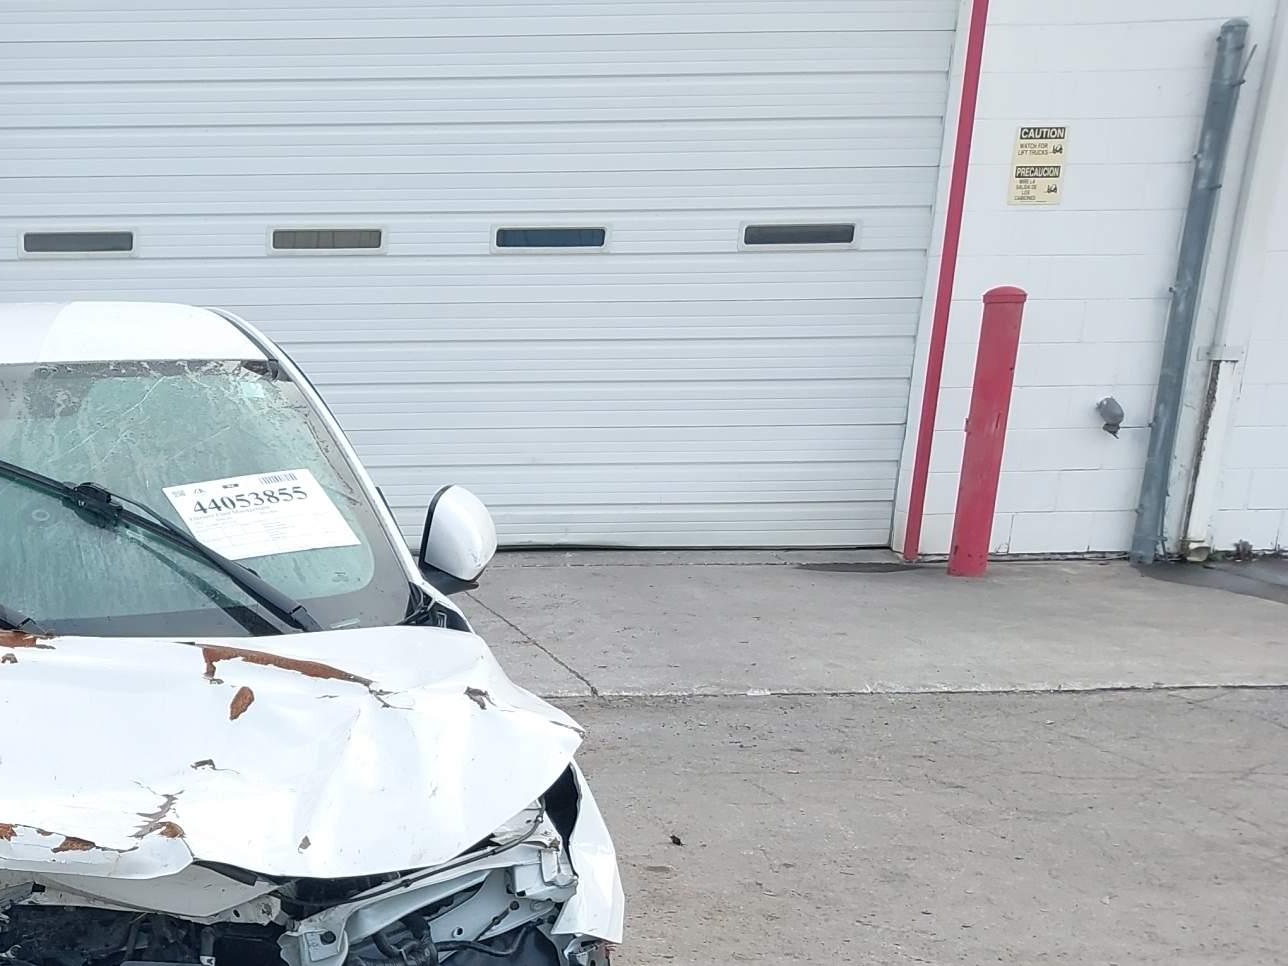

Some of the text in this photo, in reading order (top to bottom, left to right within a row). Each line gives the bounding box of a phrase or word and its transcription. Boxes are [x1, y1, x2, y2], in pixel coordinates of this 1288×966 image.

[1021, 128, 1064, 138] CAUTION
[1016, 167, 1059, 177] PRECAUCION
[193, 486, 308, 513] 44053855
